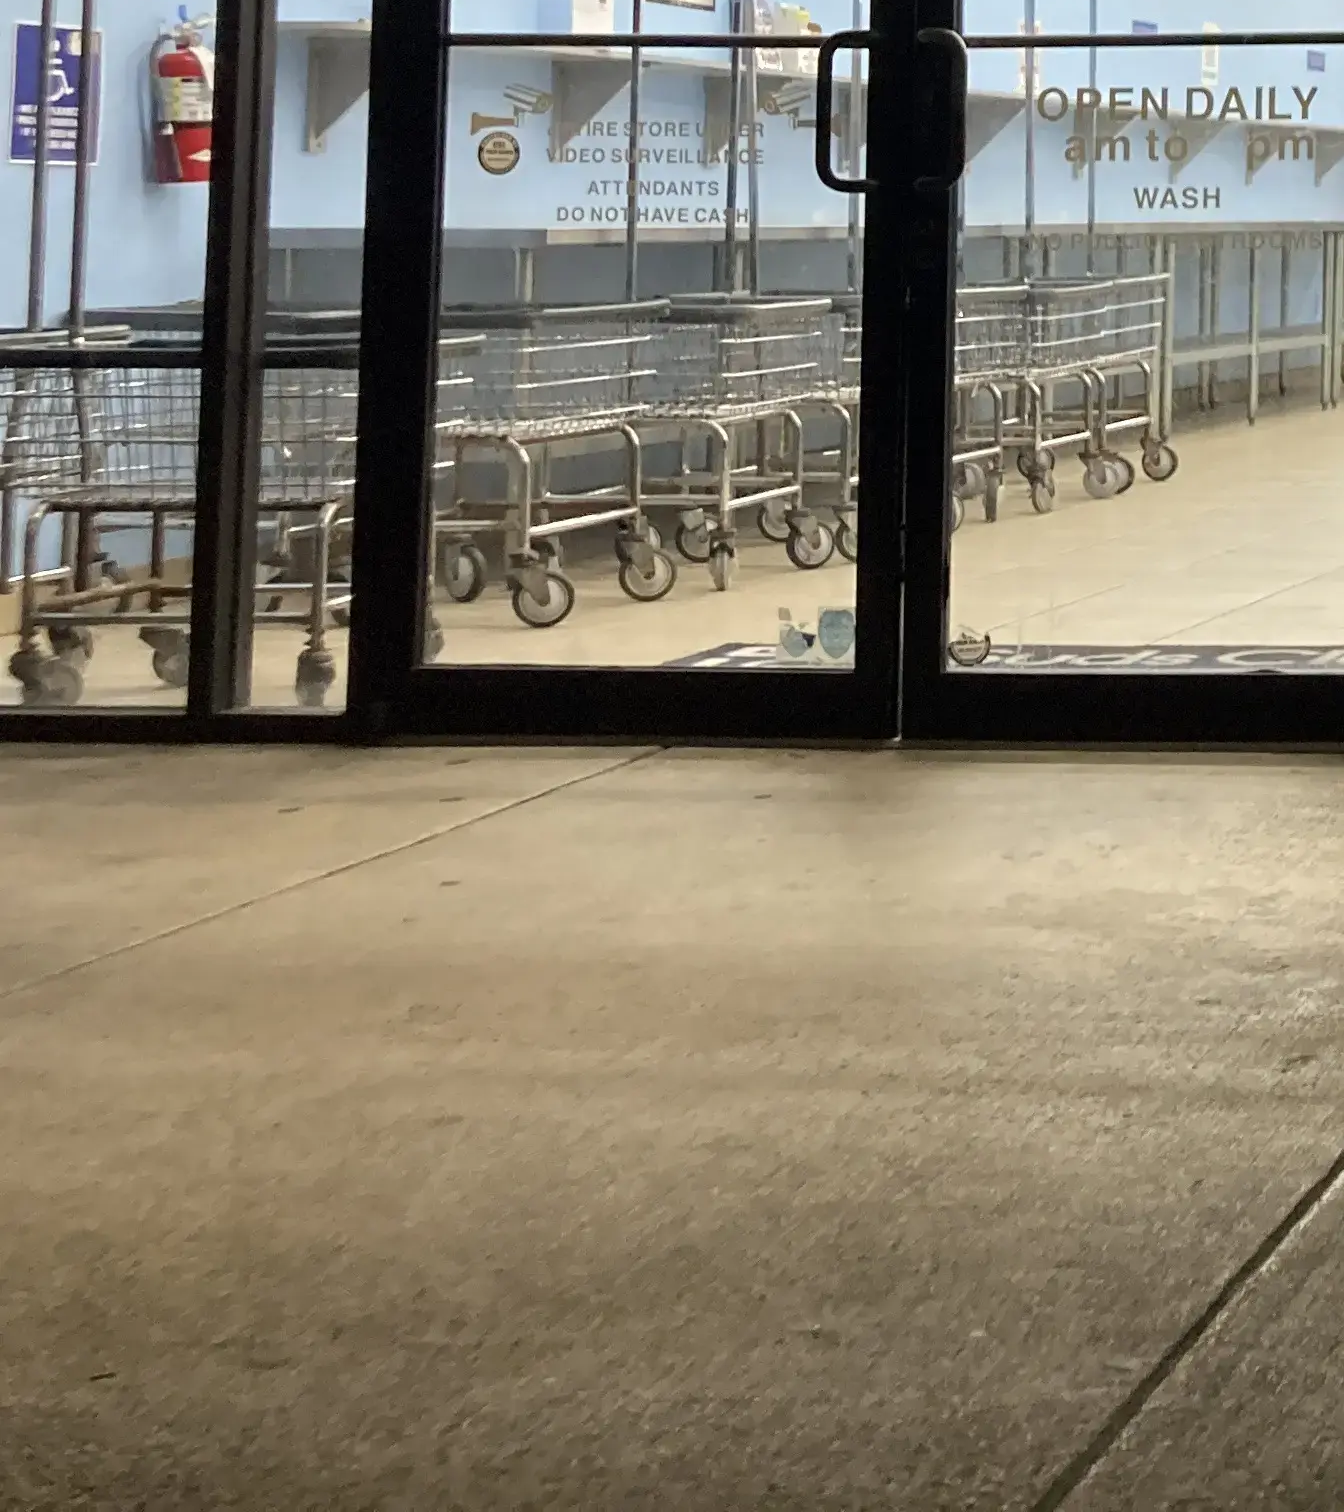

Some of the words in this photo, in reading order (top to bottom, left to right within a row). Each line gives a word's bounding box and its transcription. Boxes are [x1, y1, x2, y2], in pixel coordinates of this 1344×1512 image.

[1037, 86, 1168, 121] OPEN
[1185, 86, 1318, 120] DAILY
[624, 121, 690, 136] STORE
[696, 122, 764, 137] UER
[546, 147, 606, 163] VIDEO
[1064, 134, 1131, 162] am
[1146, 129, 1188, 162] to
[1246, 134, 1314, 170] pm
[1133, 187, 1221, 209] WASH
[557, 206, 585, 222] DO
[591, 206, 629, 222] NOT
[637, 207, 689, 222] HAVE
